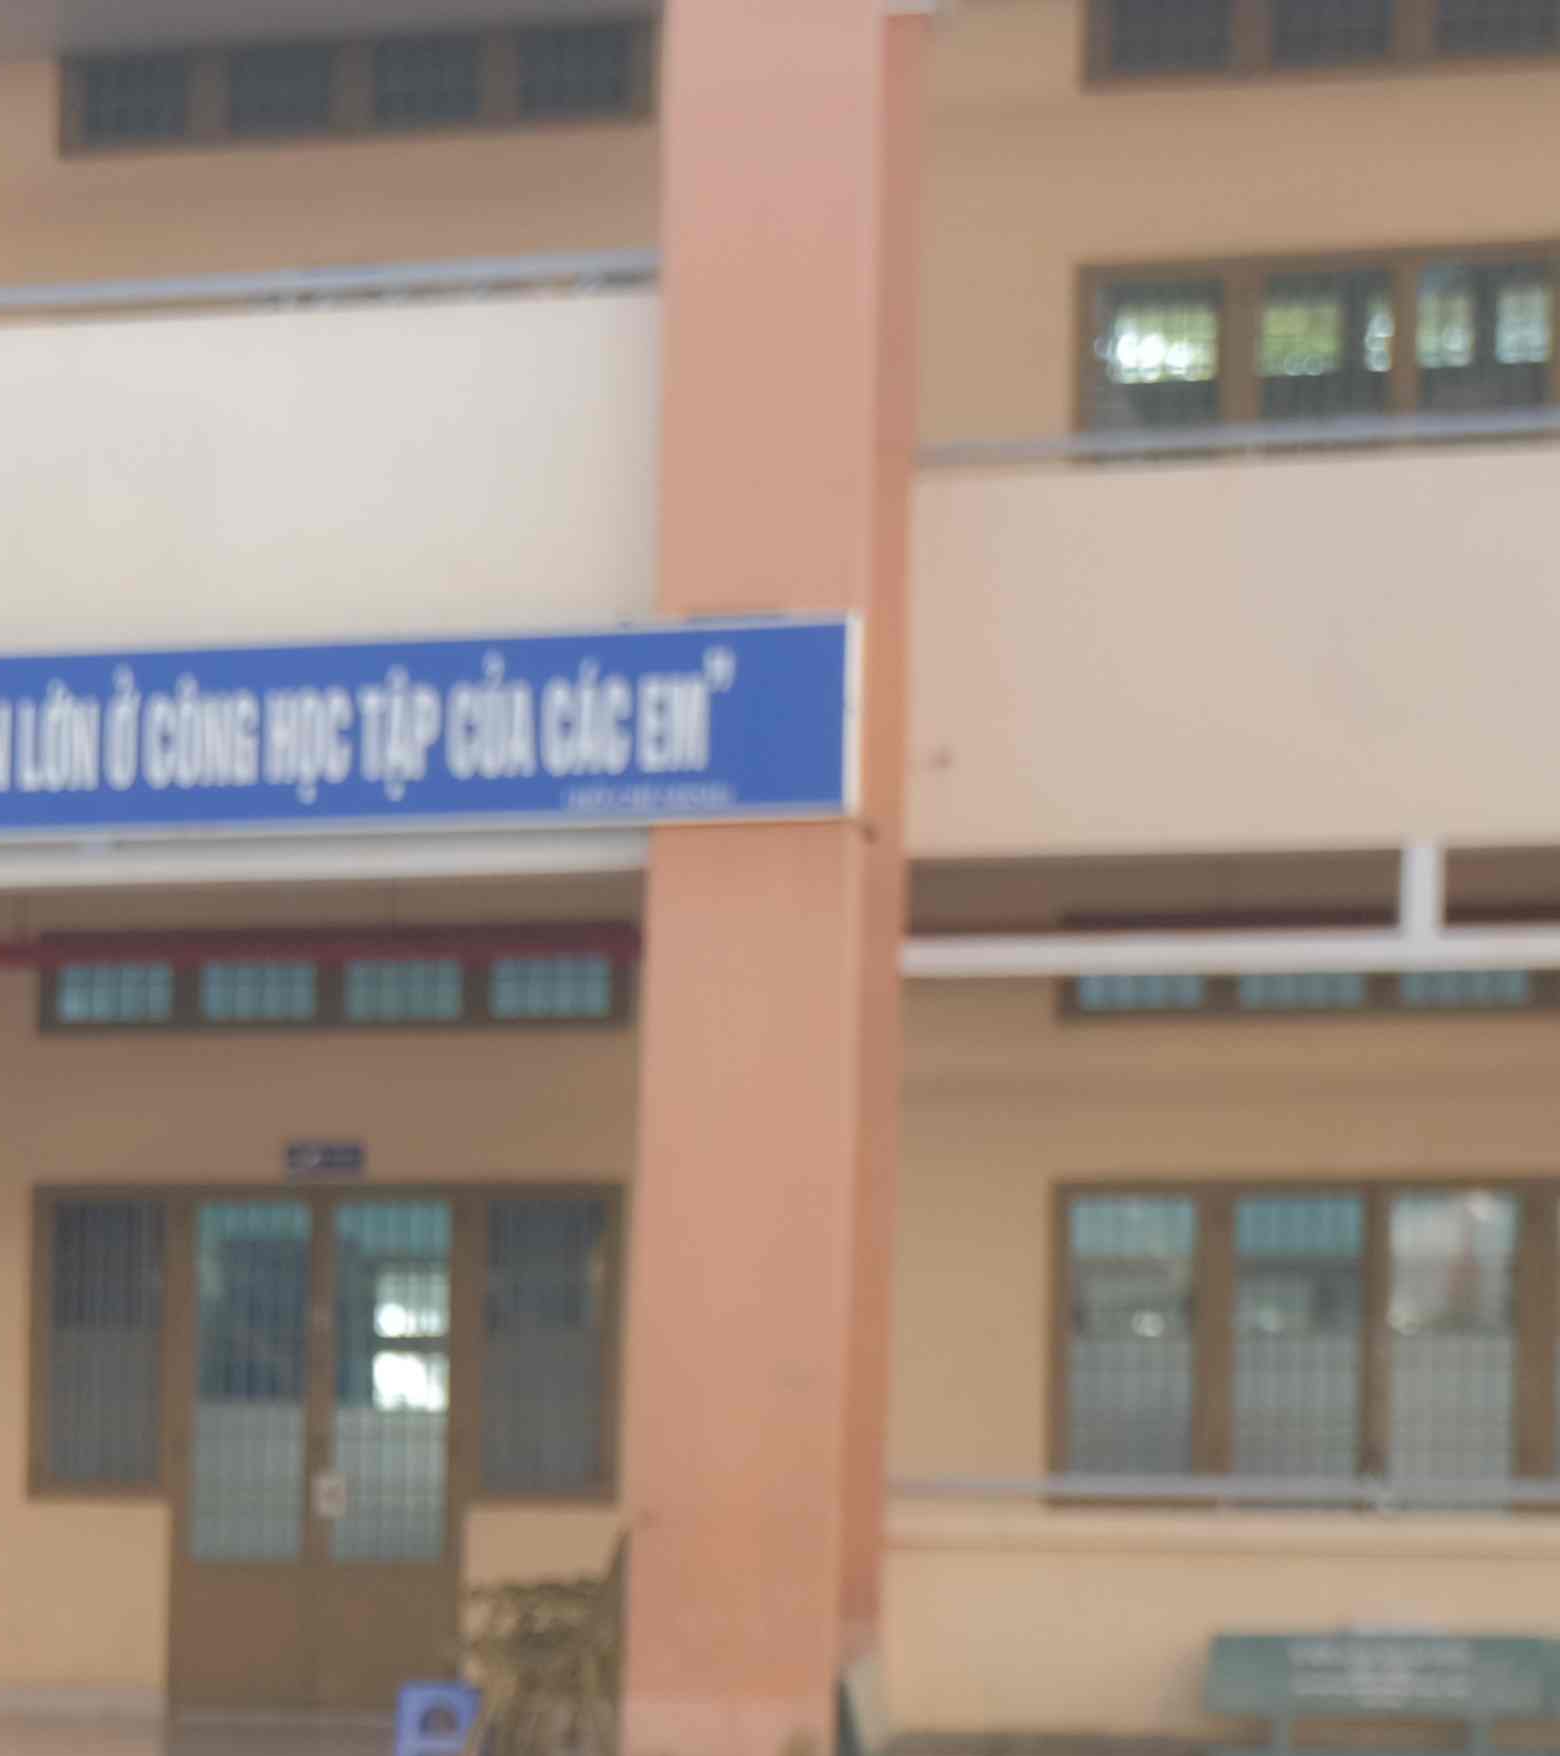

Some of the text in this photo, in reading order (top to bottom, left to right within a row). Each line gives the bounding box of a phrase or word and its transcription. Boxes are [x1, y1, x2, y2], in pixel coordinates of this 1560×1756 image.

[15, 677, 101, 794] LỚN
[104, 662, 142, 792] Ở
[143, 672, 260, 790] CÔNG
[263, 686, 354, 806] HỌC
[356, 664, 442, 802] TẬP
[445, 648, 537, 780] CỦA
[540, 656, 633, 778] CÁC
